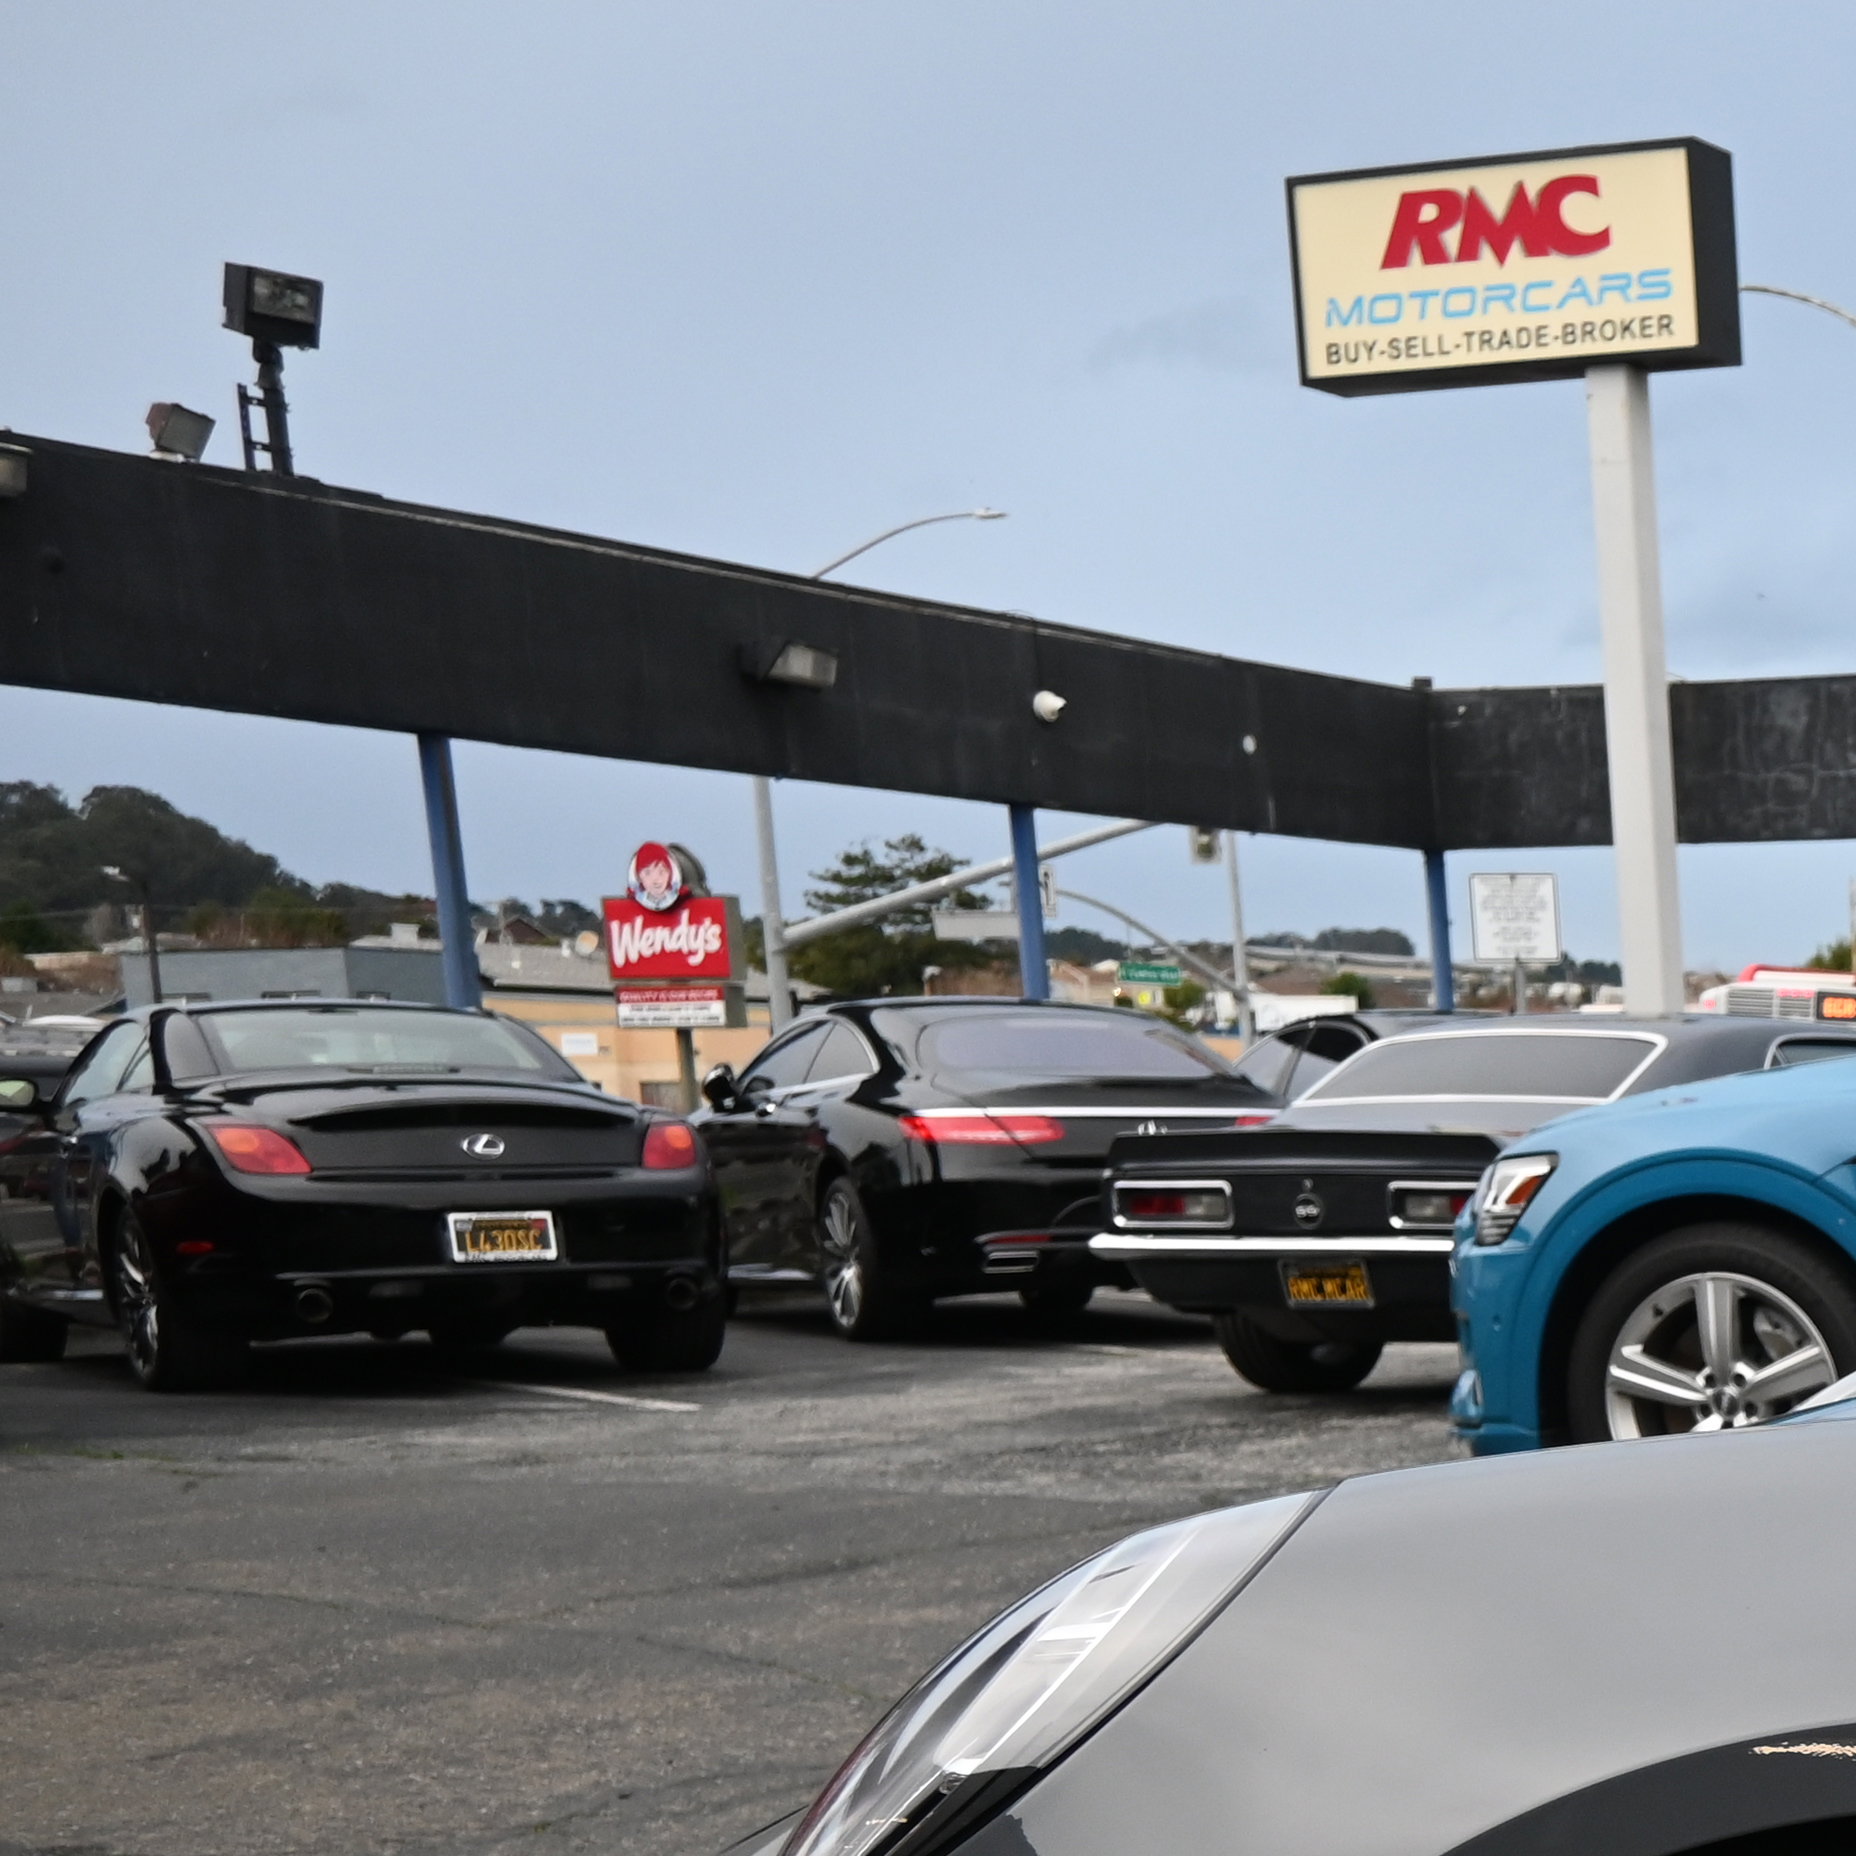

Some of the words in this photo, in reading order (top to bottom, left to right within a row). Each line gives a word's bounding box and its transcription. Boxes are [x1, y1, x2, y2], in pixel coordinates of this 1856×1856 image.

[1380, 175, 1612, 270] RMC
[1325, 268, 1673, 327] MOTORCARS
[1326, 314, 1675, 364] BUY-SELL-TRADE-BROKER
[609, 908, 723, 968] Wendy's
